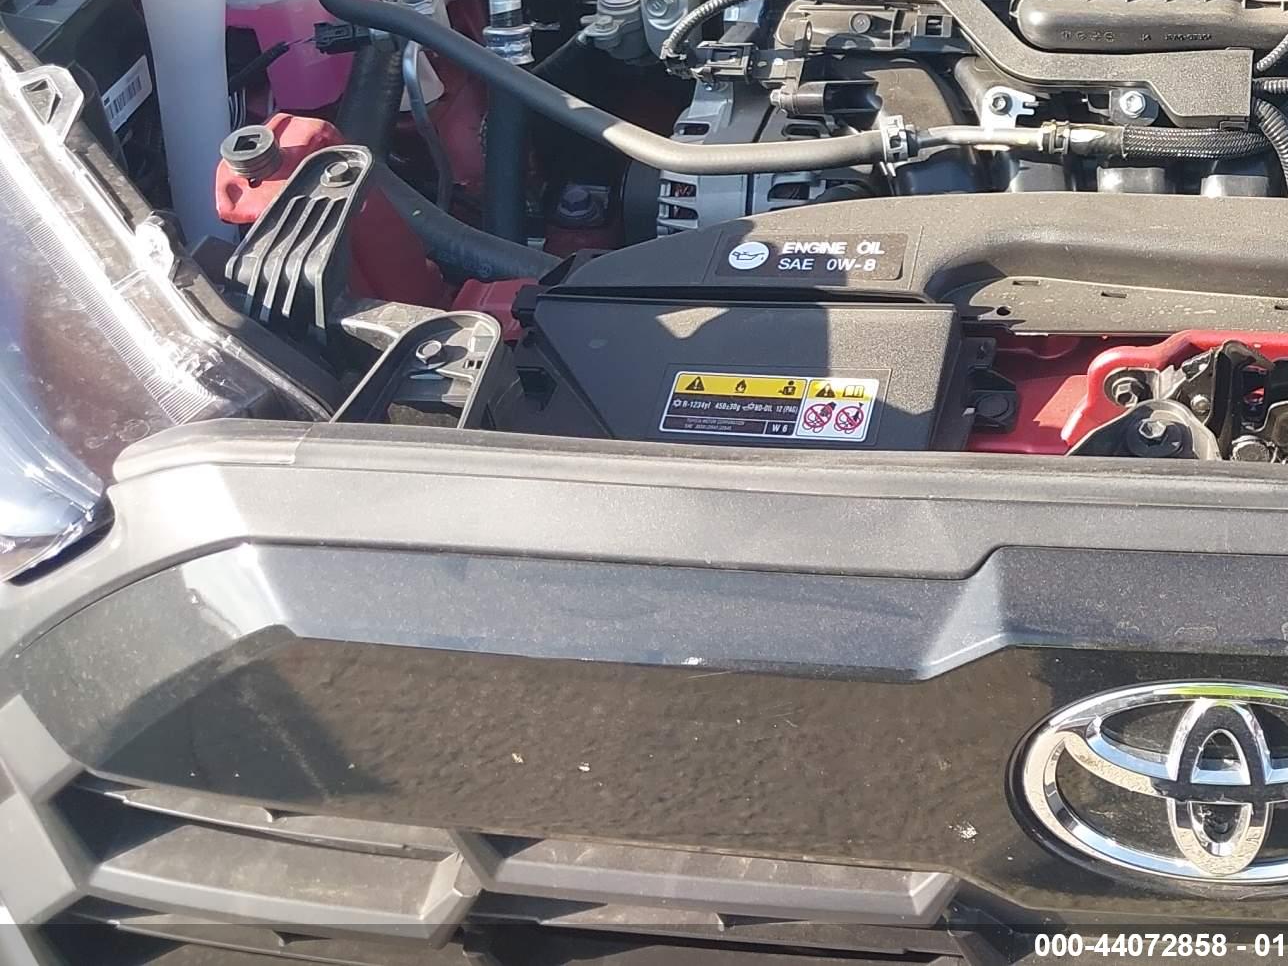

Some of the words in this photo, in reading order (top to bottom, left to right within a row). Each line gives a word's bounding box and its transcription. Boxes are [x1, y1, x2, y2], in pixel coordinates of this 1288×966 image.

[781, 241, 848, 255] ENGINE
[856, 240, 885, 255] OIL
[777, 258, 815, 271] SAE
[826, 258, 877, 272] 0W-8
[772, 424, 781, 433] W
[782, 424, 789, 433] 6
